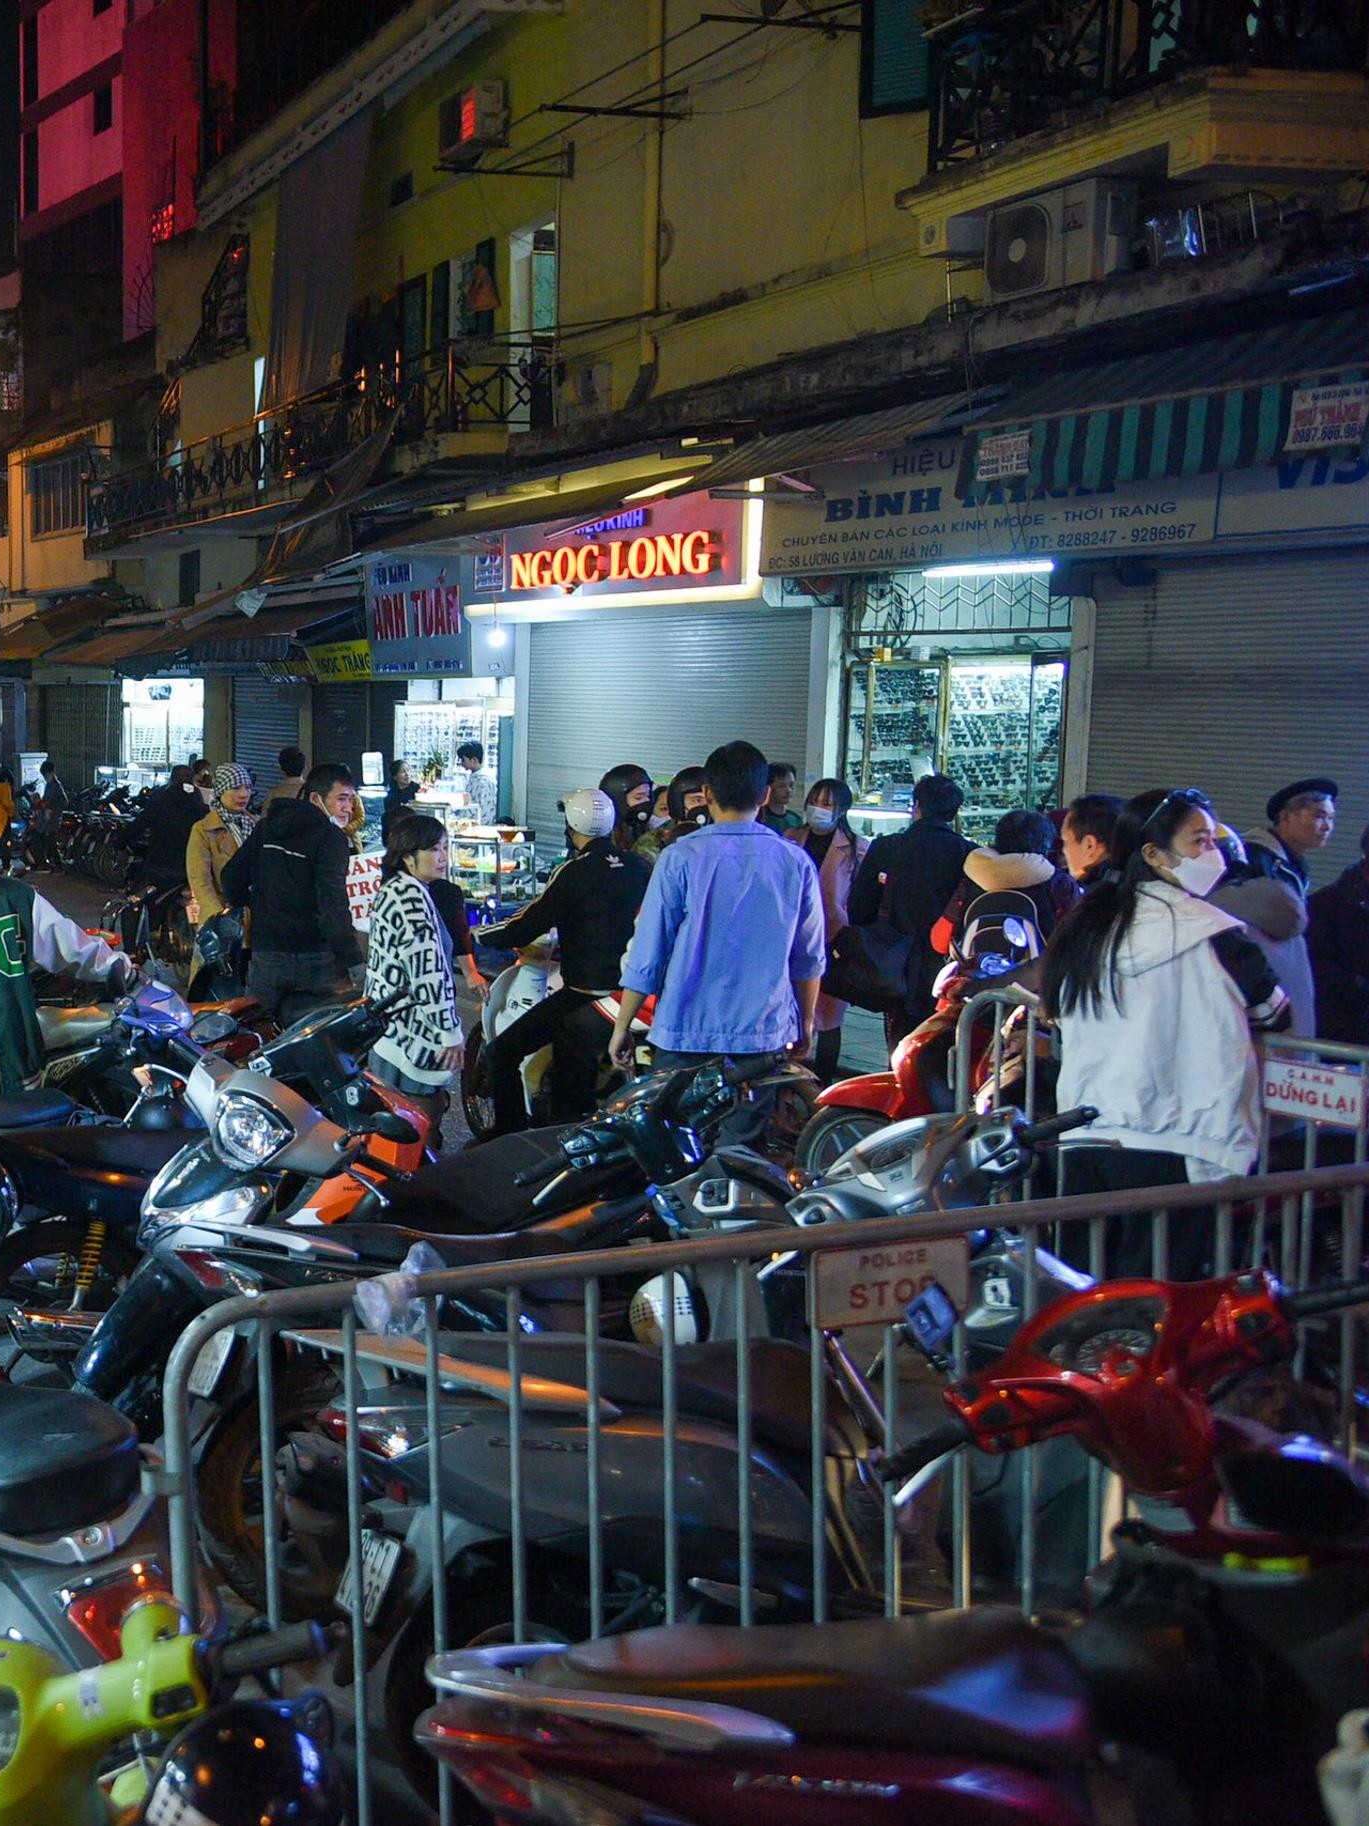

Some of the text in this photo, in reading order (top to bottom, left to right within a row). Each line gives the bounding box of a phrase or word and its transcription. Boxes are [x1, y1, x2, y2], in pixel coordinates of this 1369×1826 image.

[892, 450, 956, 476] HIỆU
[824, 486, 943, 523] BÌNH
[782, 533, 838, 549] CHUYÊN
[993, 514, 1045, 530] MODE
[1110, 501, 1177, 519] TRANG
[1057, 530, 1117, 548] 8288247
[1130, 523, 1196, 543] 9286967
[509, 529, 713, 595] NGỌC LONG
[373, 592, 409, 641] ANH
[1265, 1079, 1356, 1115] DỪNG LẠI
[859, 1249, 927, 1269] POLICE
